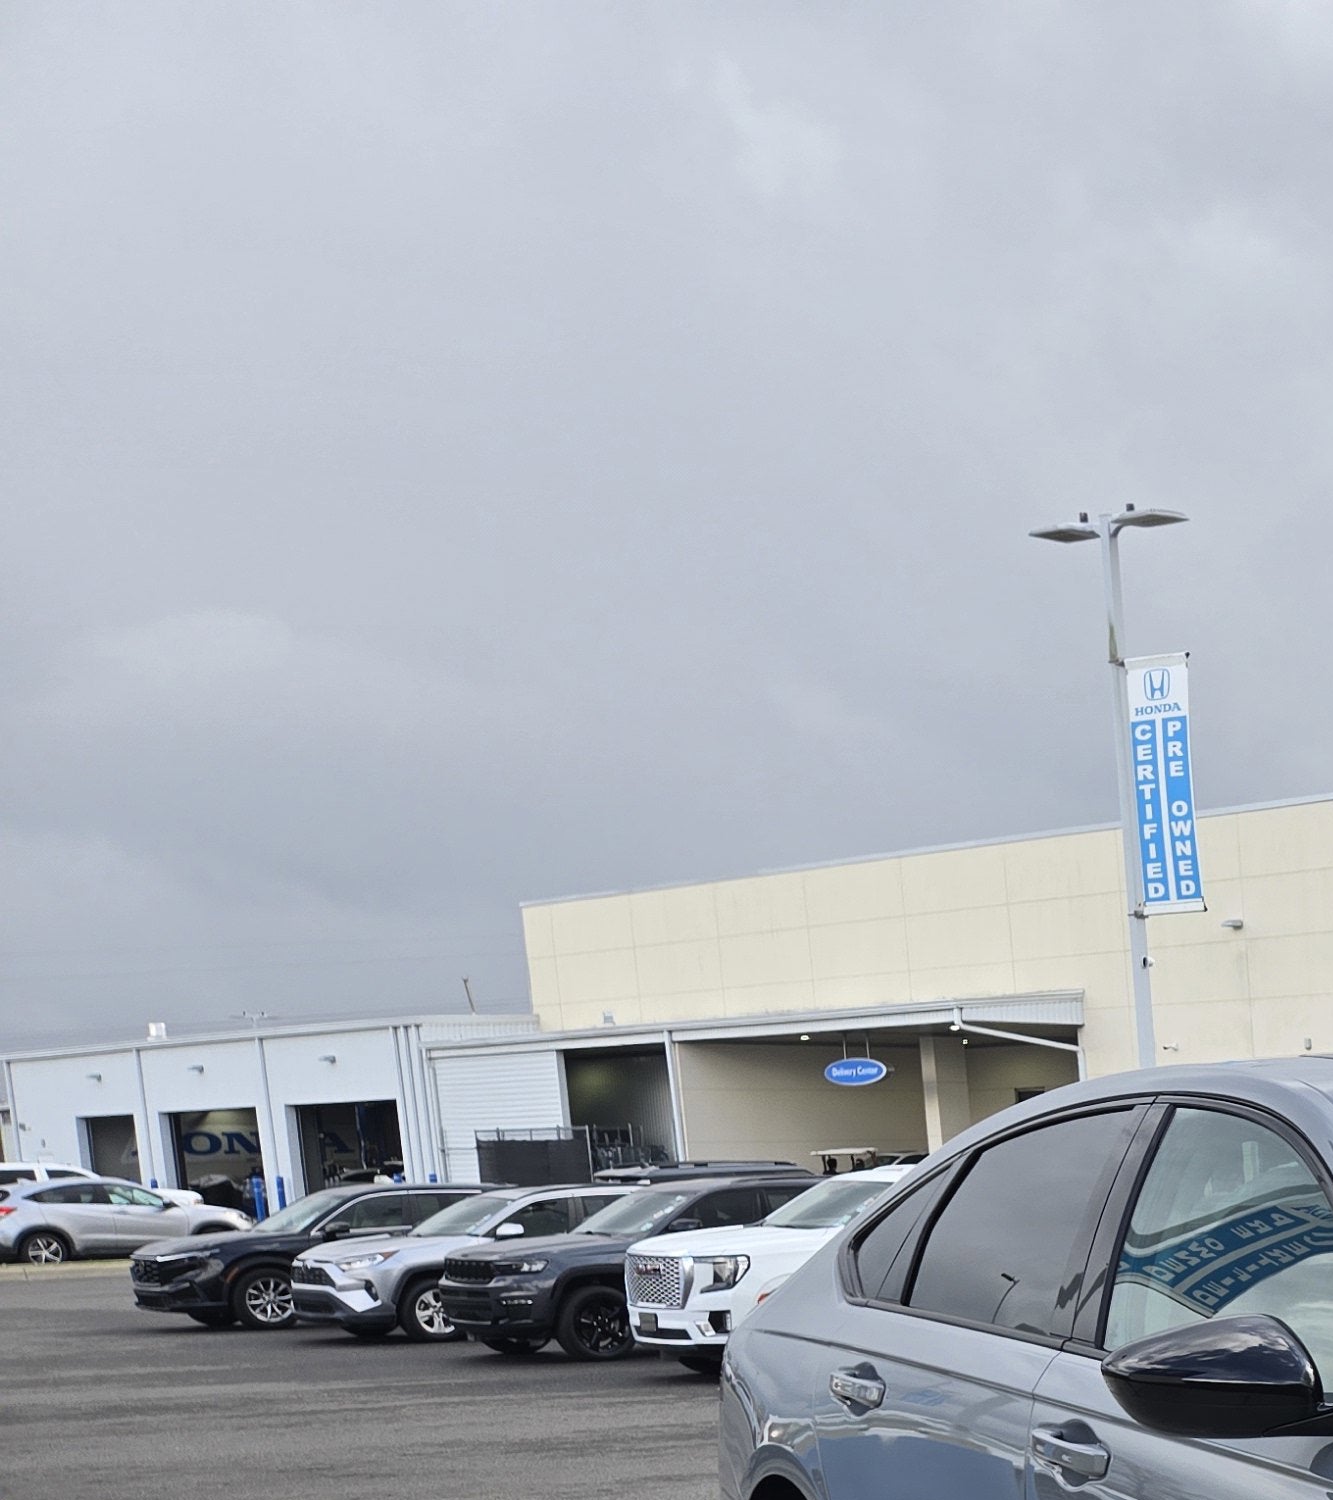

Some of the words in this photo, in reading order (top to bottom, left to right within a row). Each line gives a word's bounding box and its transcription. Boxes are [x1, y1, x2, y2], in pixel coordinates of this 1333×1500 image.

[1134, 701, 1182, 717] HONDA
[1166, 719, 1185, 778] PRE
[1134, 723, 1166, 899] CERTIFIED
[1170, 800, 1196, 898] OWNED
